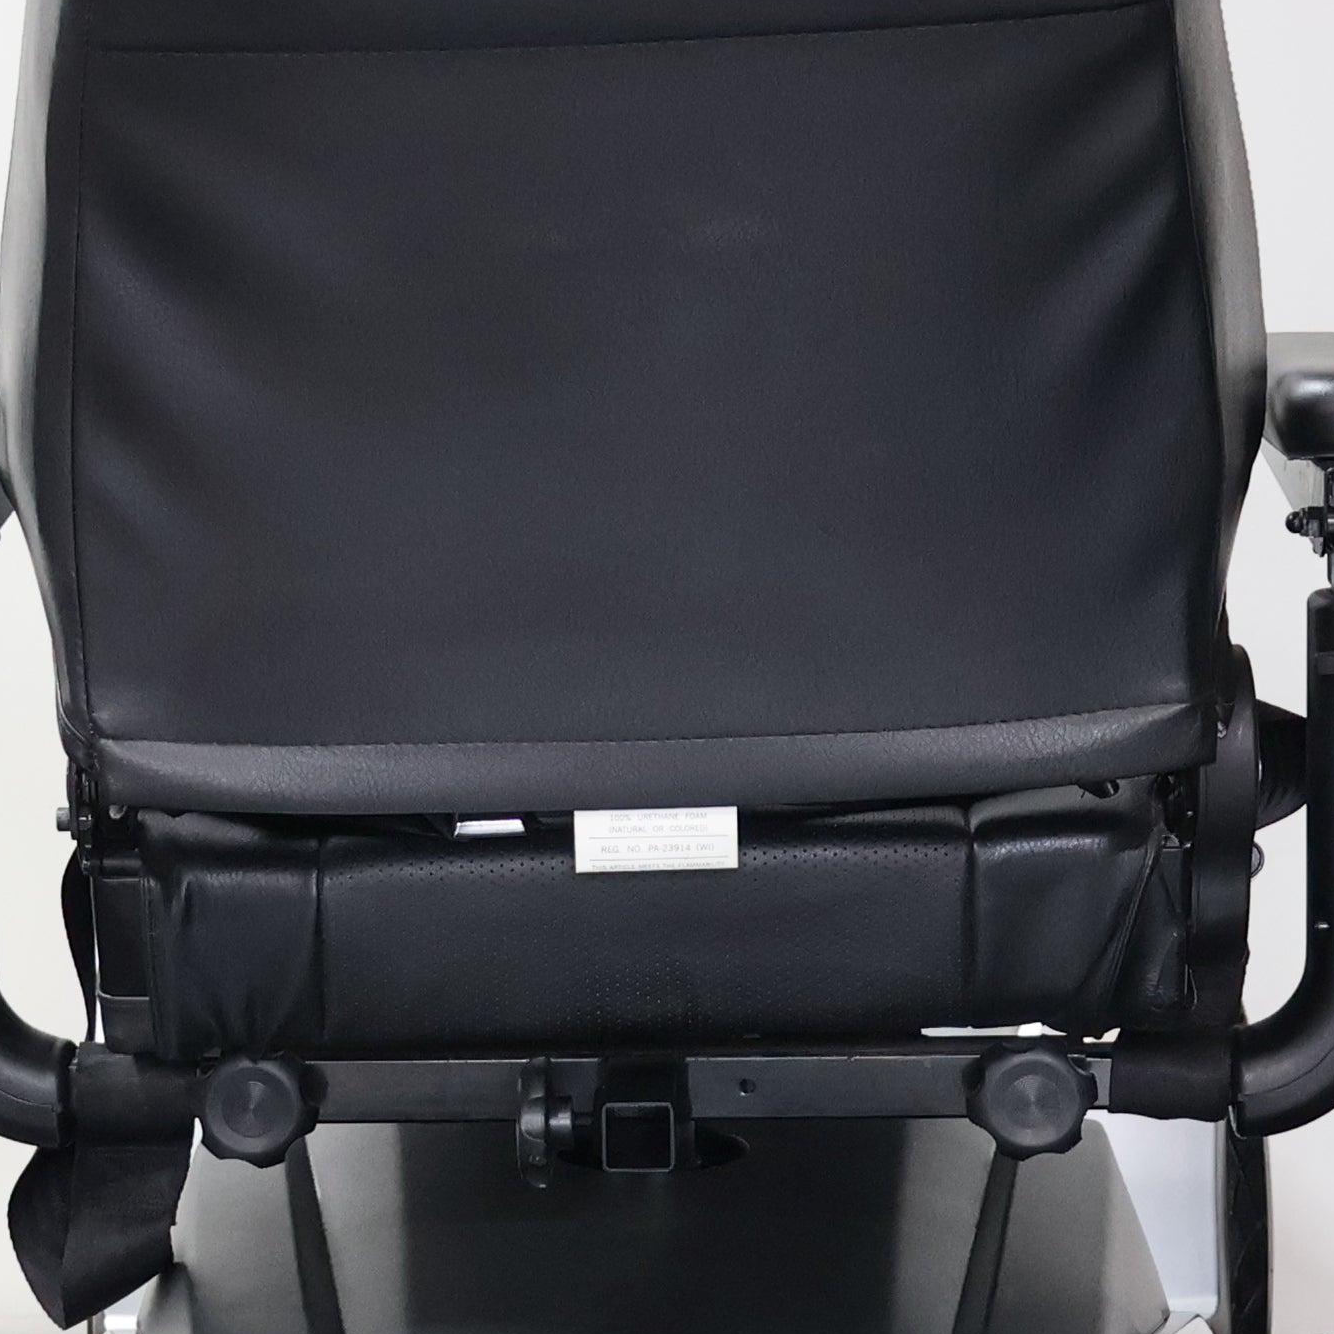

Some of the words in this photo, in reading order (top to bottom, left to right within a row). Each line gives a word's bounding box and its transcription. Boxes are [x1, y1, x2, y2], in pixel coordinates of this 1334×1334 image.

[610, 814, 632, 822] 100%
[637, 813, 680, 821] URETHANE
[685, 812, 708, 820] FOAM
[653, 825, 664, 833] OR
